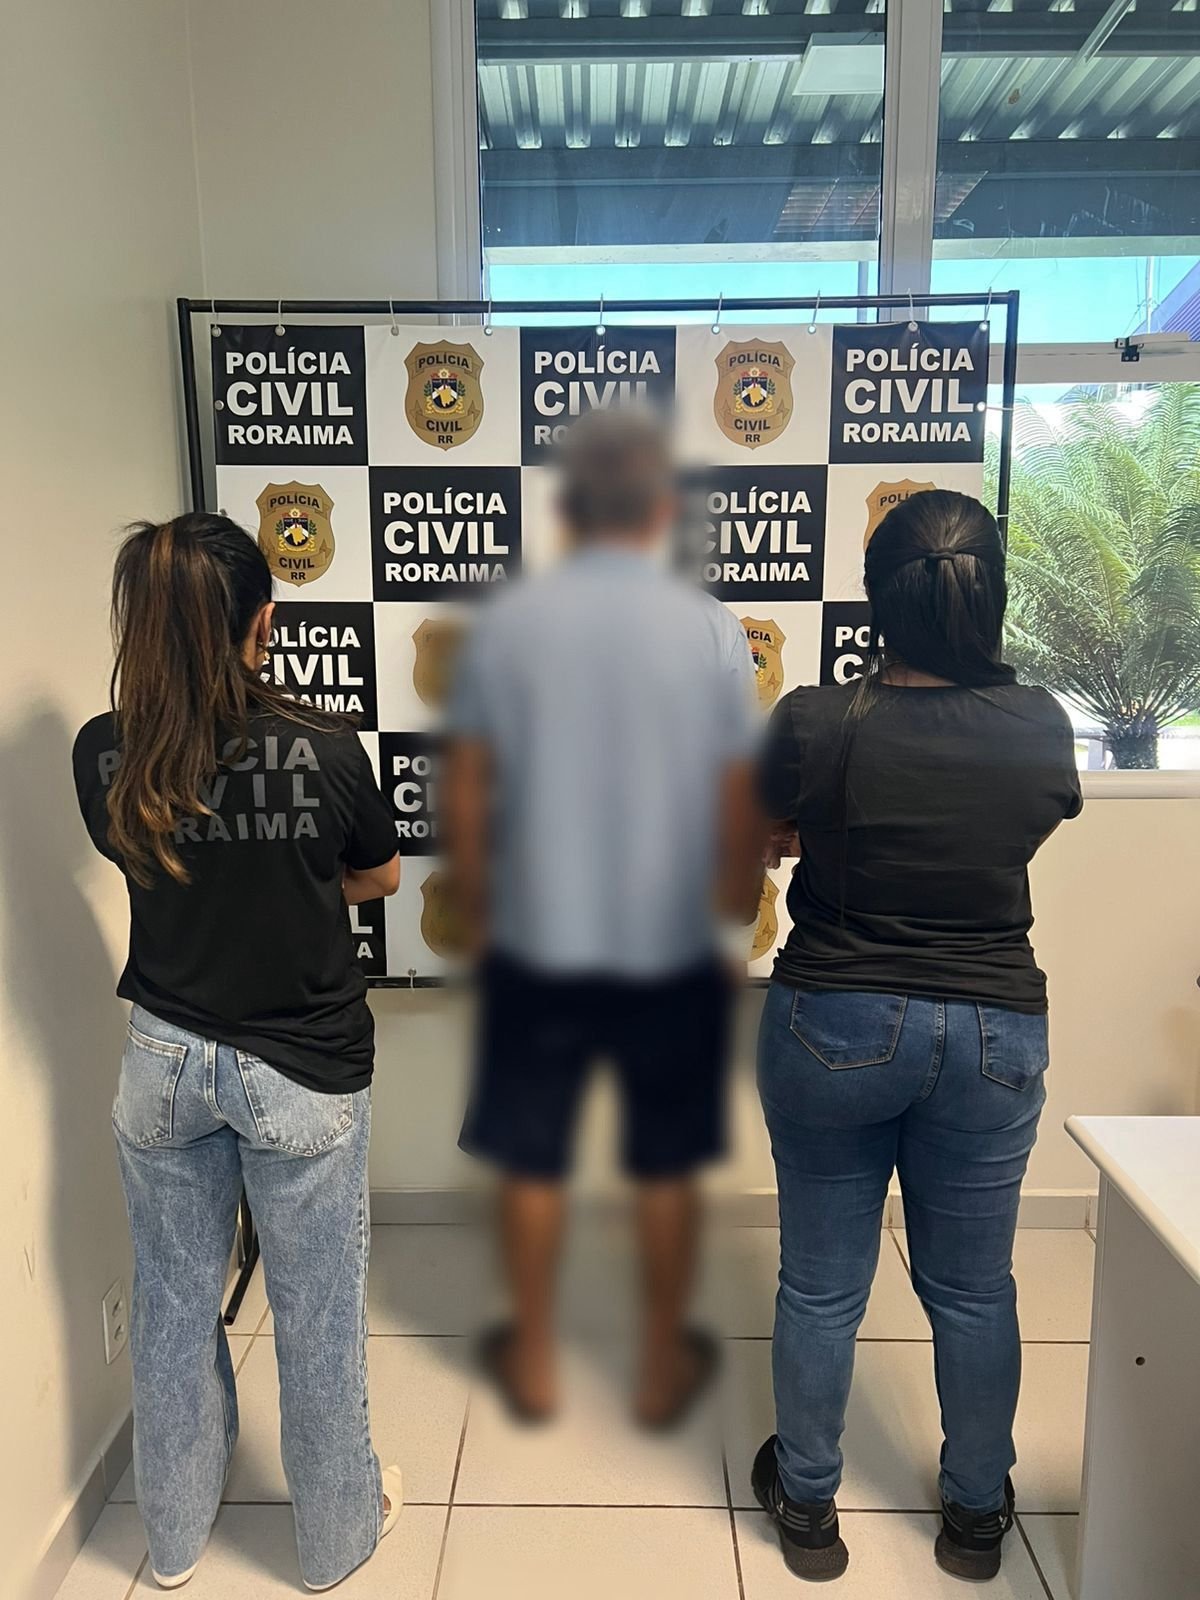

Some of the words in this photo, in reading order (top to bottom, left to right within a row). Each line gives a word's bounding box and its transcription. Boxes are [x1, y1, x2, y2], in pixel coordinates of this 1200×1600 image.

[226, 347, 351, 375] POLÍCIA
[418, 352, 470, 369] POLÍCIA
[534, 346, 661, 374] POLÍCIA
[728, 352, 781, 368] POLÍCIA
[846, 343, 974, 372] POLÍCIA
[226, 381, 353, 416] CIVIL
[844, 378, 974, 414] CIVIL
[426, 419, 462, 432] CIVIL
[734, 418, 771, 431] CIVIL
[842, 422, 972, 443] RORAIMA
[228, 425, 354, 445] RORAIMA
[437, 435, 453, 444] RR
[745, 434, 761, 443] RR
[269, 494, 321, 509] POLÍCIA
[383, 487, 507, 515] POLÍCIA
[706, 486, 812, 514] OLÍCIA
[880, 490, 909, 506] POLÍ
[383, 520, 509, 555] CIVIL
[279, 556, 315, 570] CIVIL
[385, 563, 508, 583] RORAIMA
[703, 562, 810, 582] ORAIMA
[290, 571, 306, 581] RR
[268, 621, 361, 648] LÍCIA
[199, 773, 320, 809] VIL
[174, 812, 319, 844] RAIMA
